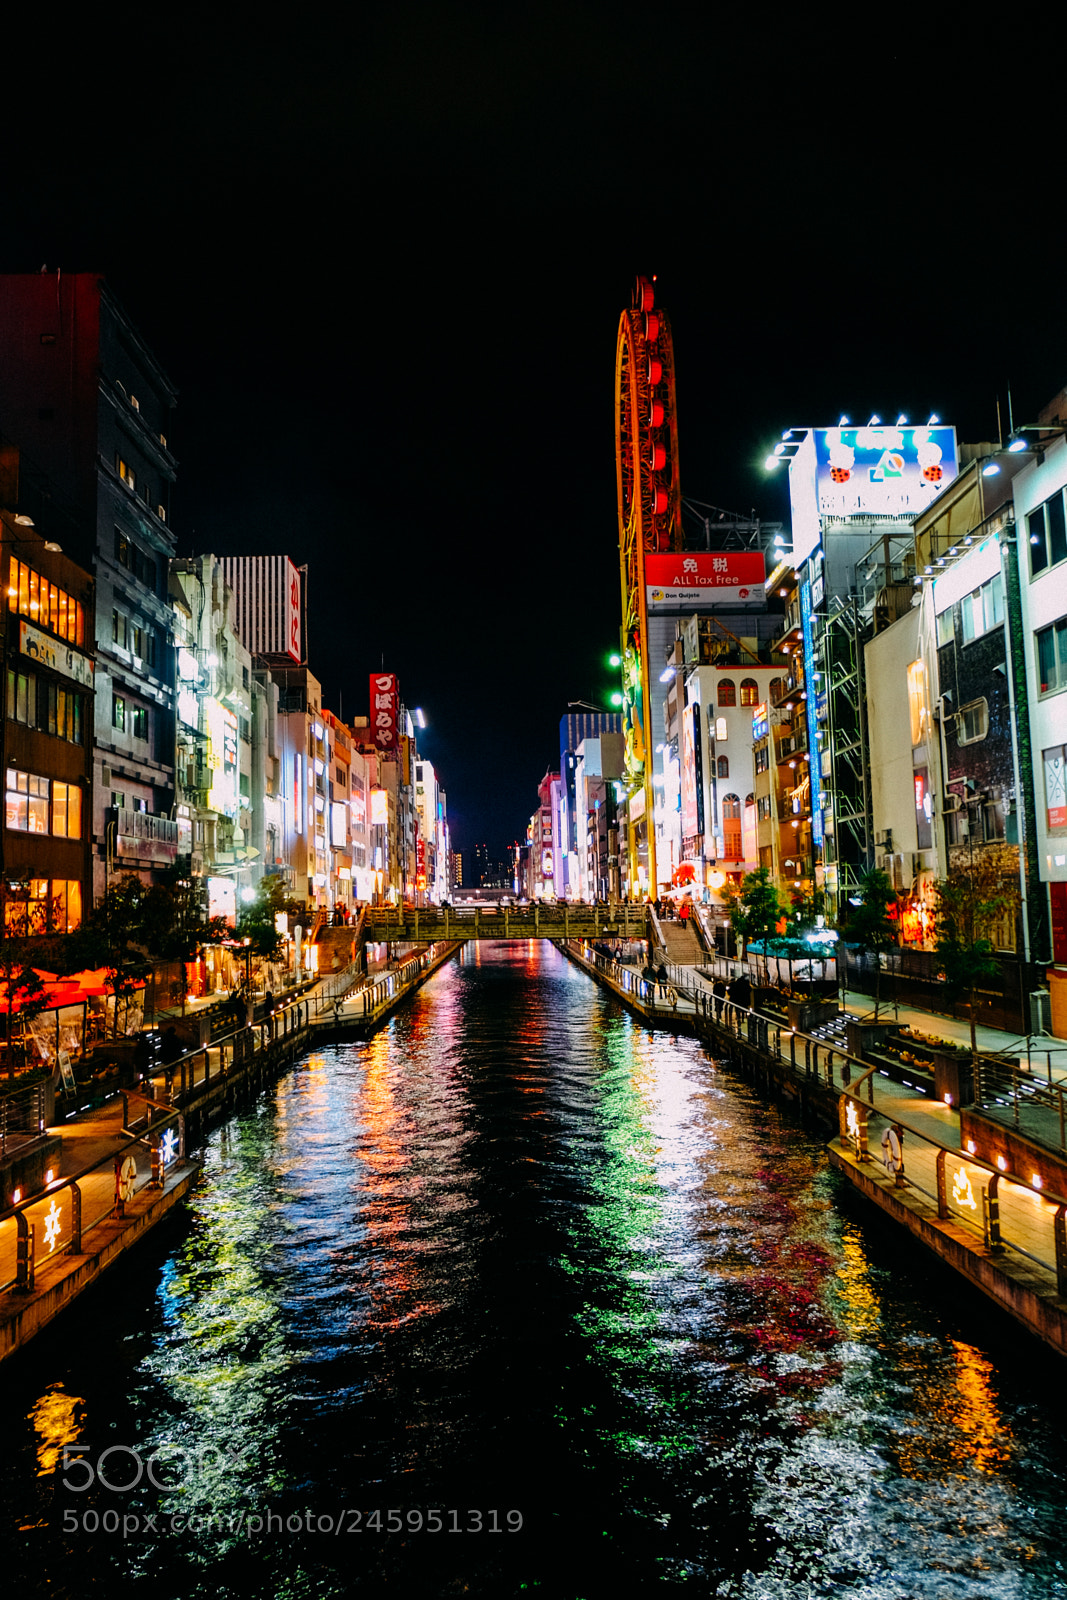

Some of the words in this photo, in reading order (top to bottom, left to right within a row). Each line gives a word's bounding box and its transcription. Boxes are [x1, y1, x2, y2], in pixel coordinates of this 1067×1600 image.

[673, 576, 691, 585] ALL
[694, 576, 713, 584] Tax
[716, 575, 739, 584] Free
[678, 592, 700, 600] Quijote
[375, 674, 395, 746] づぼらや
